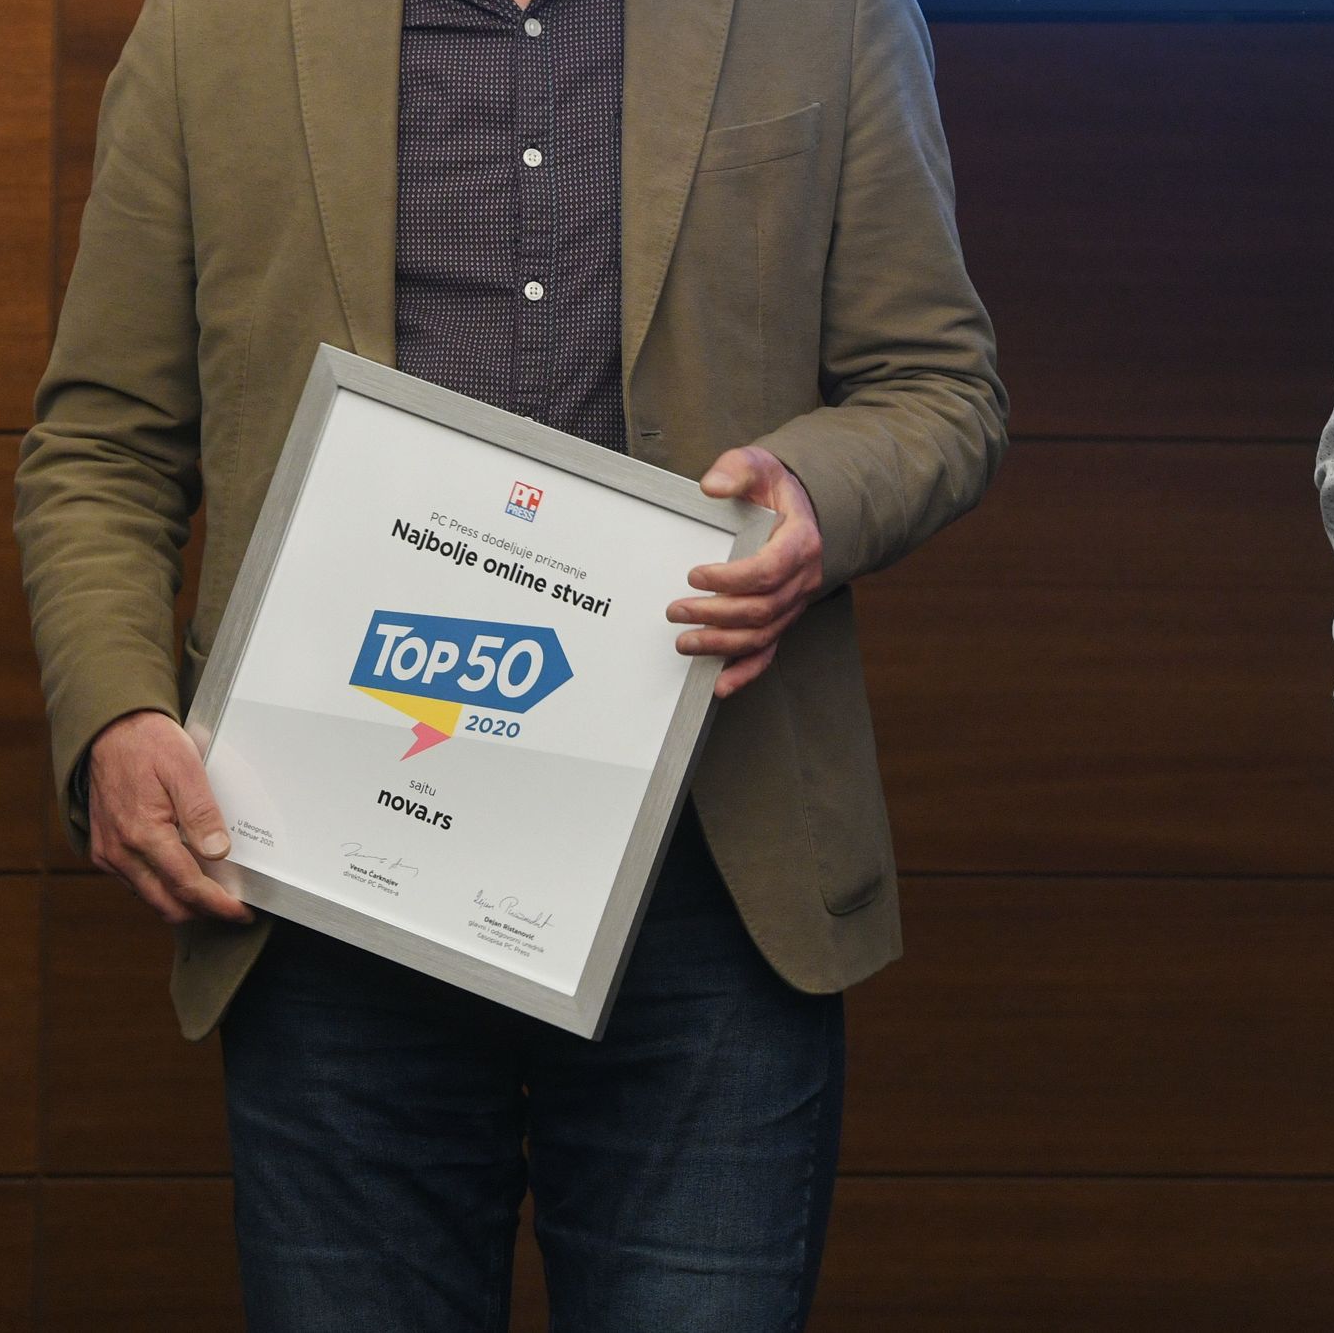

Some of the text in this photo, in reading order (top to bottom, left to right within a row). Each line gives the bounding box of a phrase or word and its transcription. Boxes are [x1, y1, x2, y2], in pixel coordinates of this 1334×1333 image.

[506, 503, 536, 521] PRESS
[430, 512, 587, 579] PC Press dodeljuje priznanje
[391, 519, 611, 617] Najbolje online stvari
[373, 623, 544, 699] TOP 50
[465, 715, 520, 738] 2020
[409, 779, 437, 797] sajtu
[377, 789, 453, 830] nova.rs
[350, 863, 367, 875] Vesna
[367, 879, 377, 888] PC
[484, 916, 502, 928] Dejan
